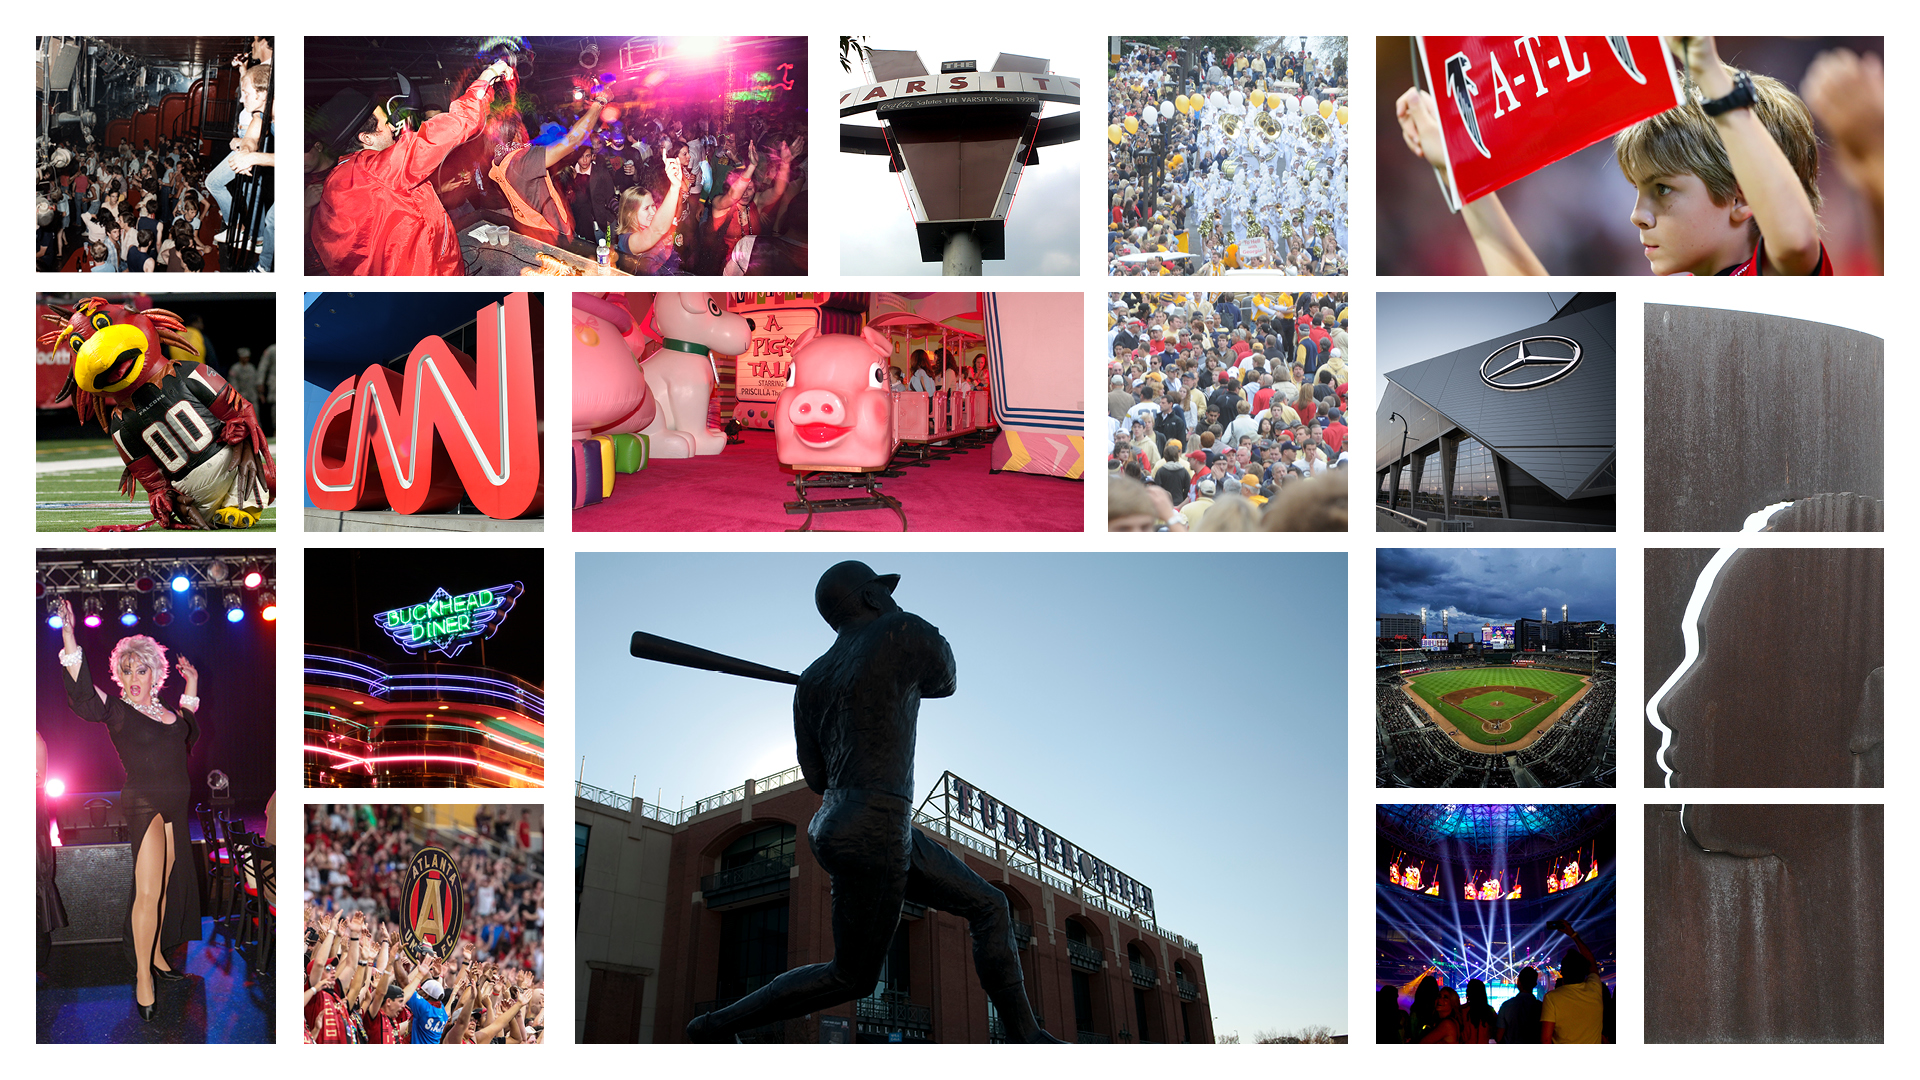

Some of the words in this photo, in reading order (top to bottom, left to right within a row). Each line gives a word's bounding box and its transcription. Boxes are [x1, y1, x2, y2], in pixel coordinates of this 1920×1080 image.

[943, 61, 974, 69] THE
[1490, 36, 1591, 119] A-T-L
[840, 76, 1080, 104] ARSIT
[916, 98, 943, 106] Salutes
[763, 314, 783, 332] A
[752, 335, 796, 357] PIG'S
[138, 393, 166, 416] FALCONS
[741, 388, 771, 396] PRISCILLA
[305, 292, 541, 520] CNN
[142, 400, 214, 474] 00
[387, 589, 494, 627] BUCKHEAD
[411, 614, 471, 641] DINER
[953, 778, 1077, 874] TURNER
[1093, 858, 1155, 912] FIELD
[412, 853, 457, 887] ATLANTA
[857, 1022, 889, 1034] WILL
